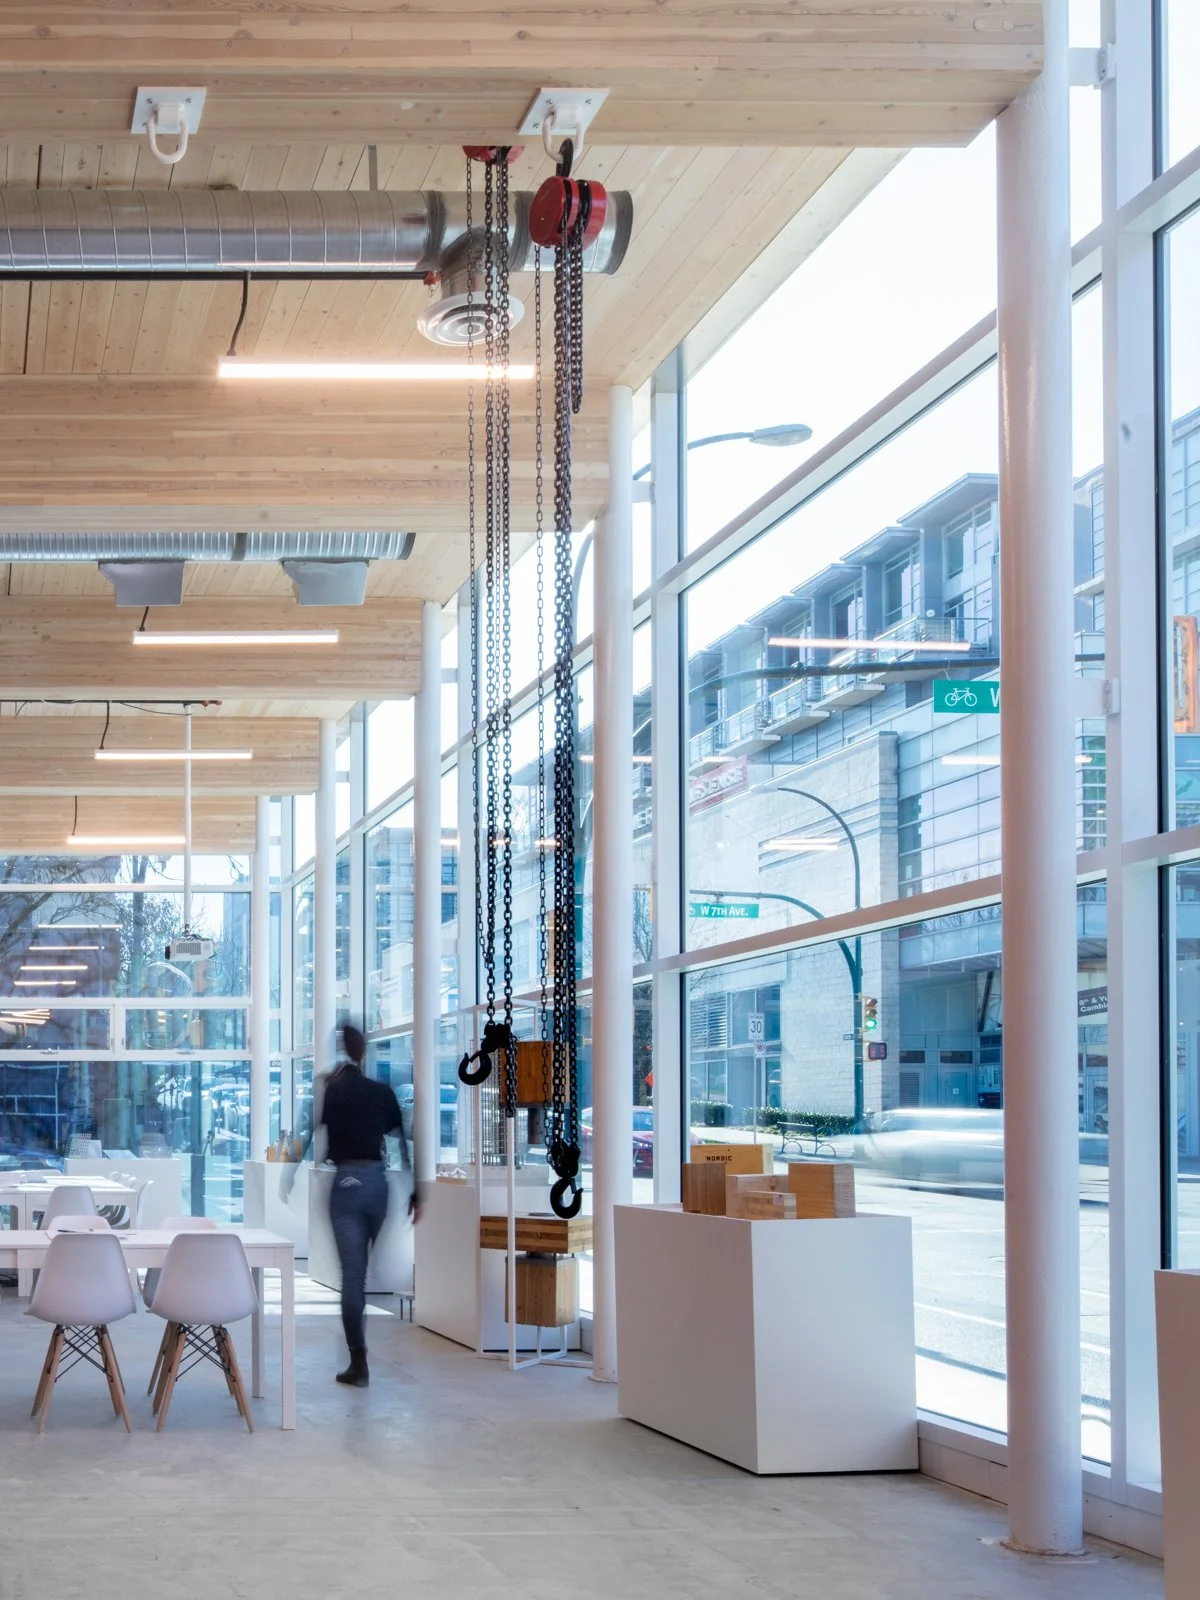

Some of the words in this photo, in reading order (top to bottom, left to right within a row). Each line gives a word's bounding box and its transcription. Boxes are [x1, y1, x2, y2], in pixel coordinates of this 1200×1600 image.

[700, 905, 710, 916] W
[711, 906, 728, 917] 7TH
[750, 1020, 762, 1033] 30
